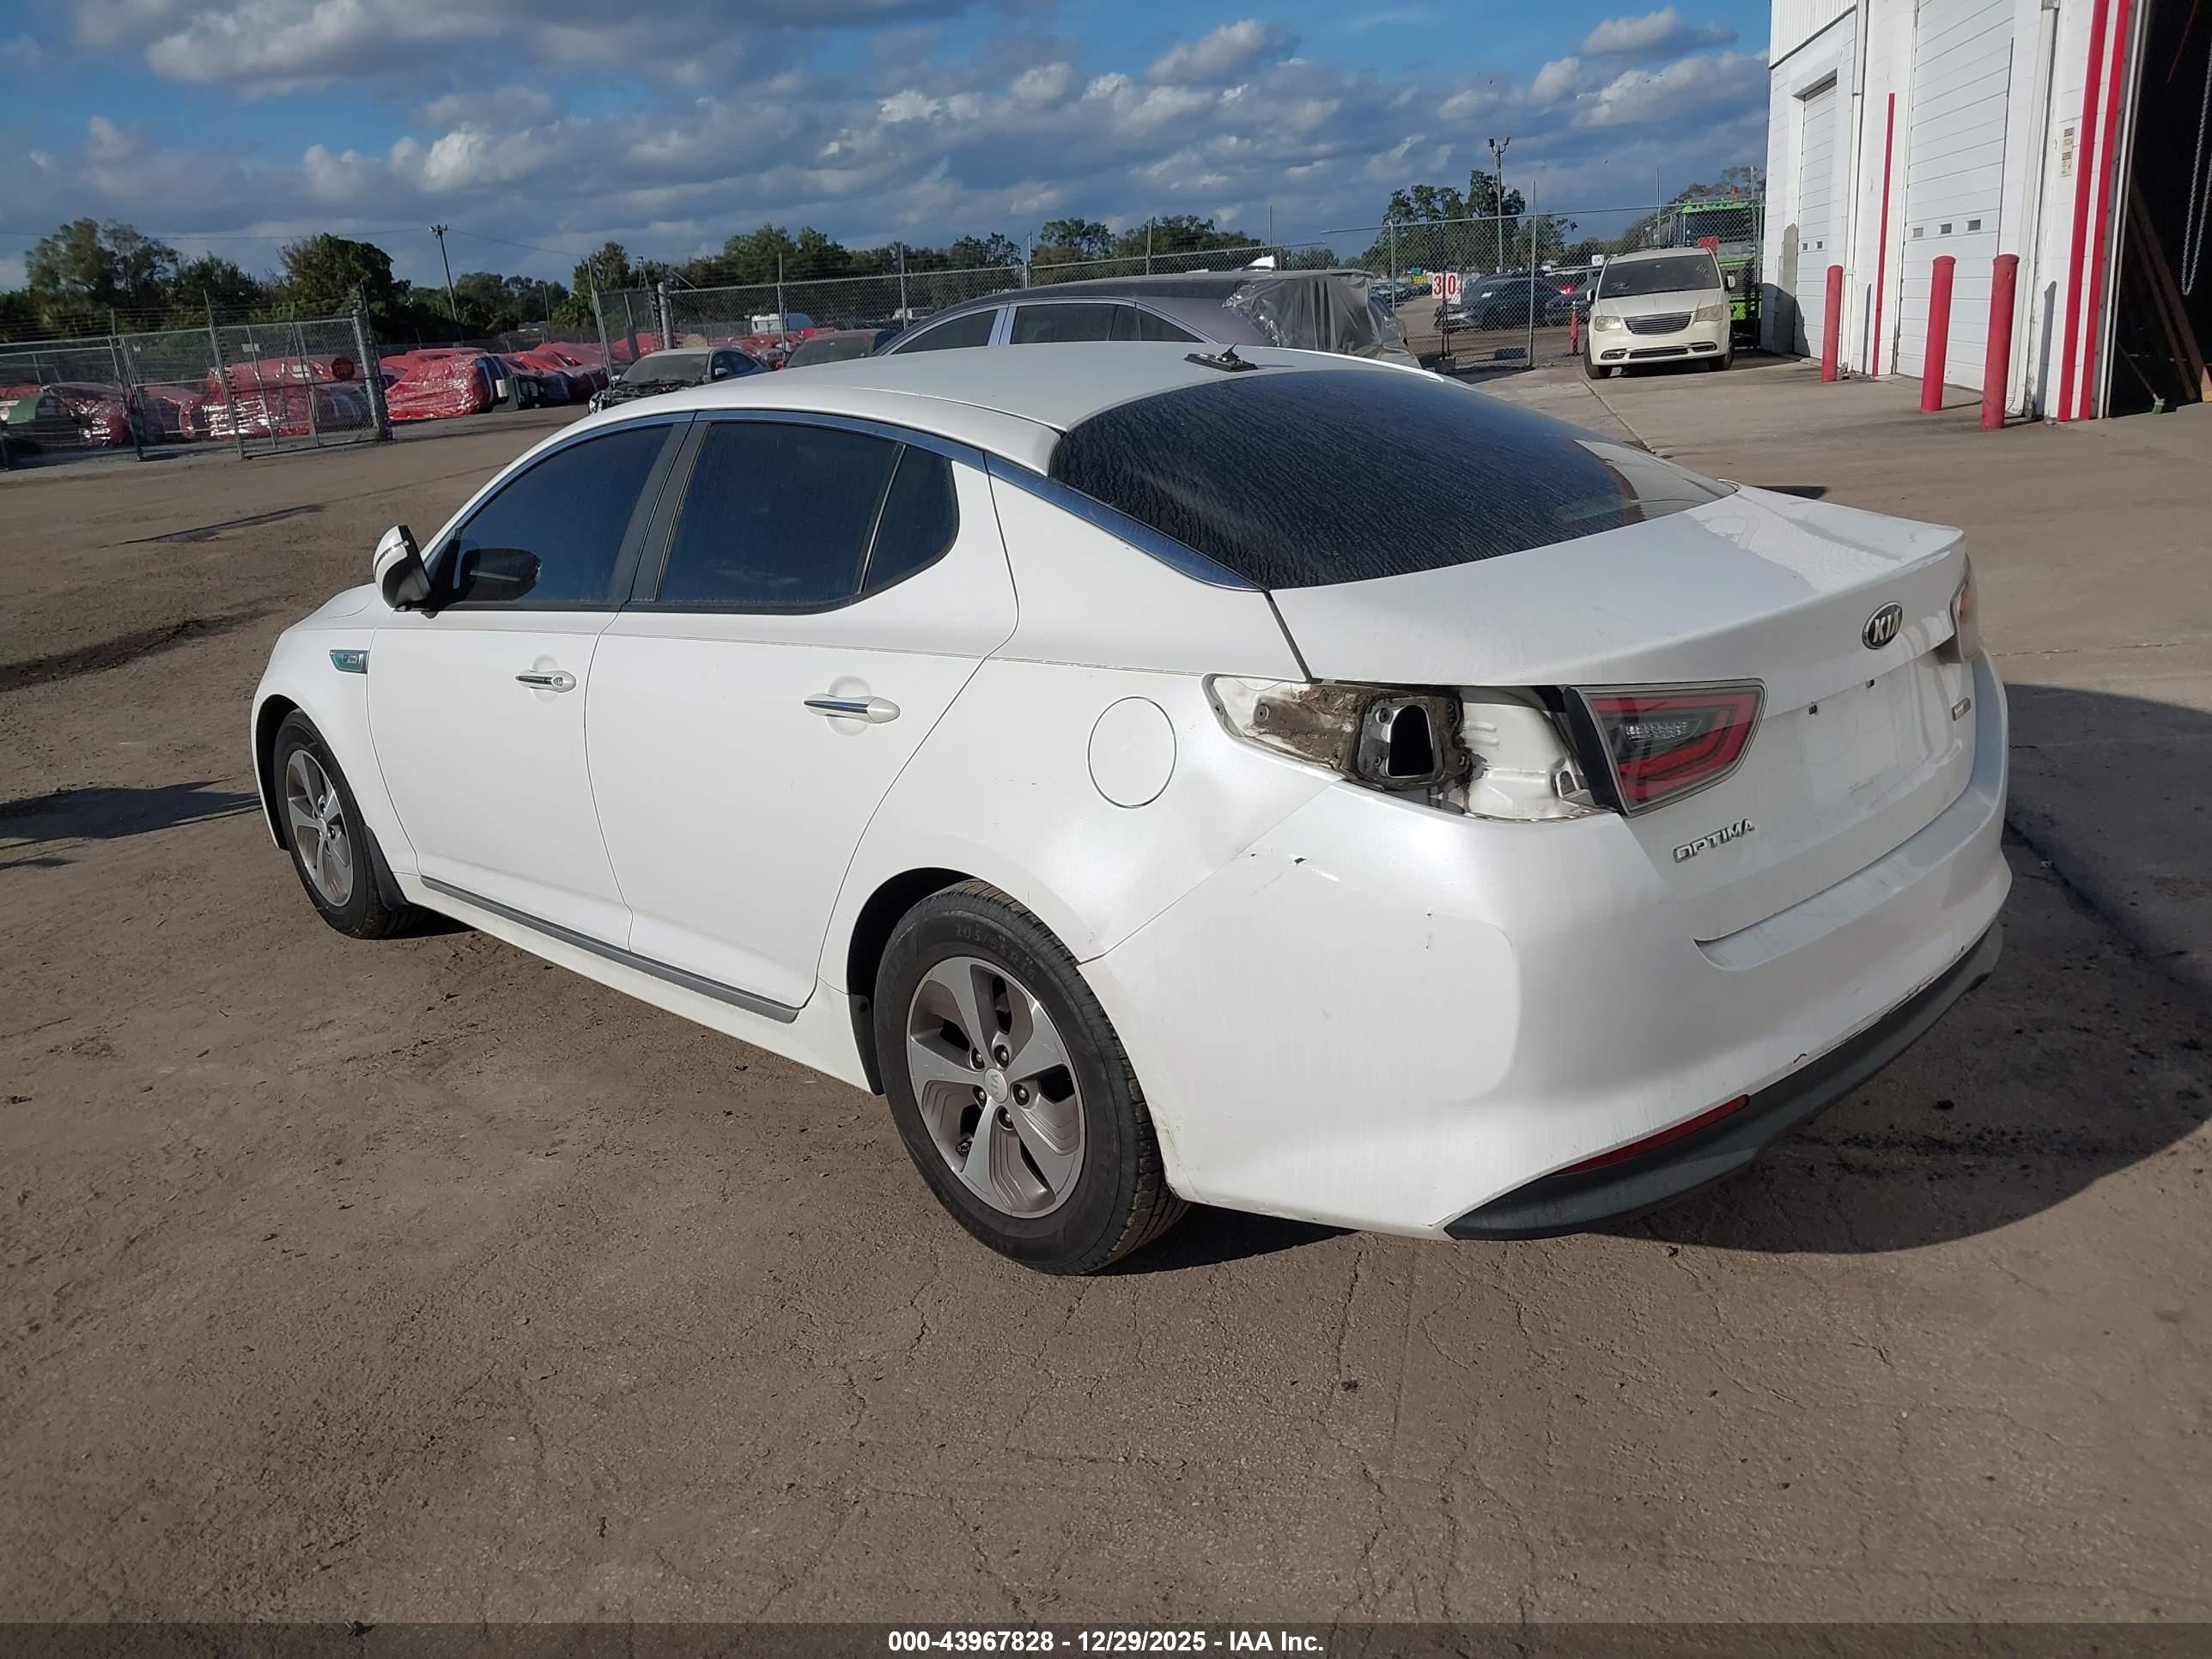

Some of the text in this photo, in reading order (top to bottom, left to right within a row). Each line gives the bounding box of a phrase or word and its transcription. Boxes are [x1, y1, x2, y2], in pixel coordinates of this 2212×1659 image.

[1434, 275, 1456, 295] 30
[1872, 611, 1900, 643] KIA
[1673, 818, 1755, 864] OPTIMA
